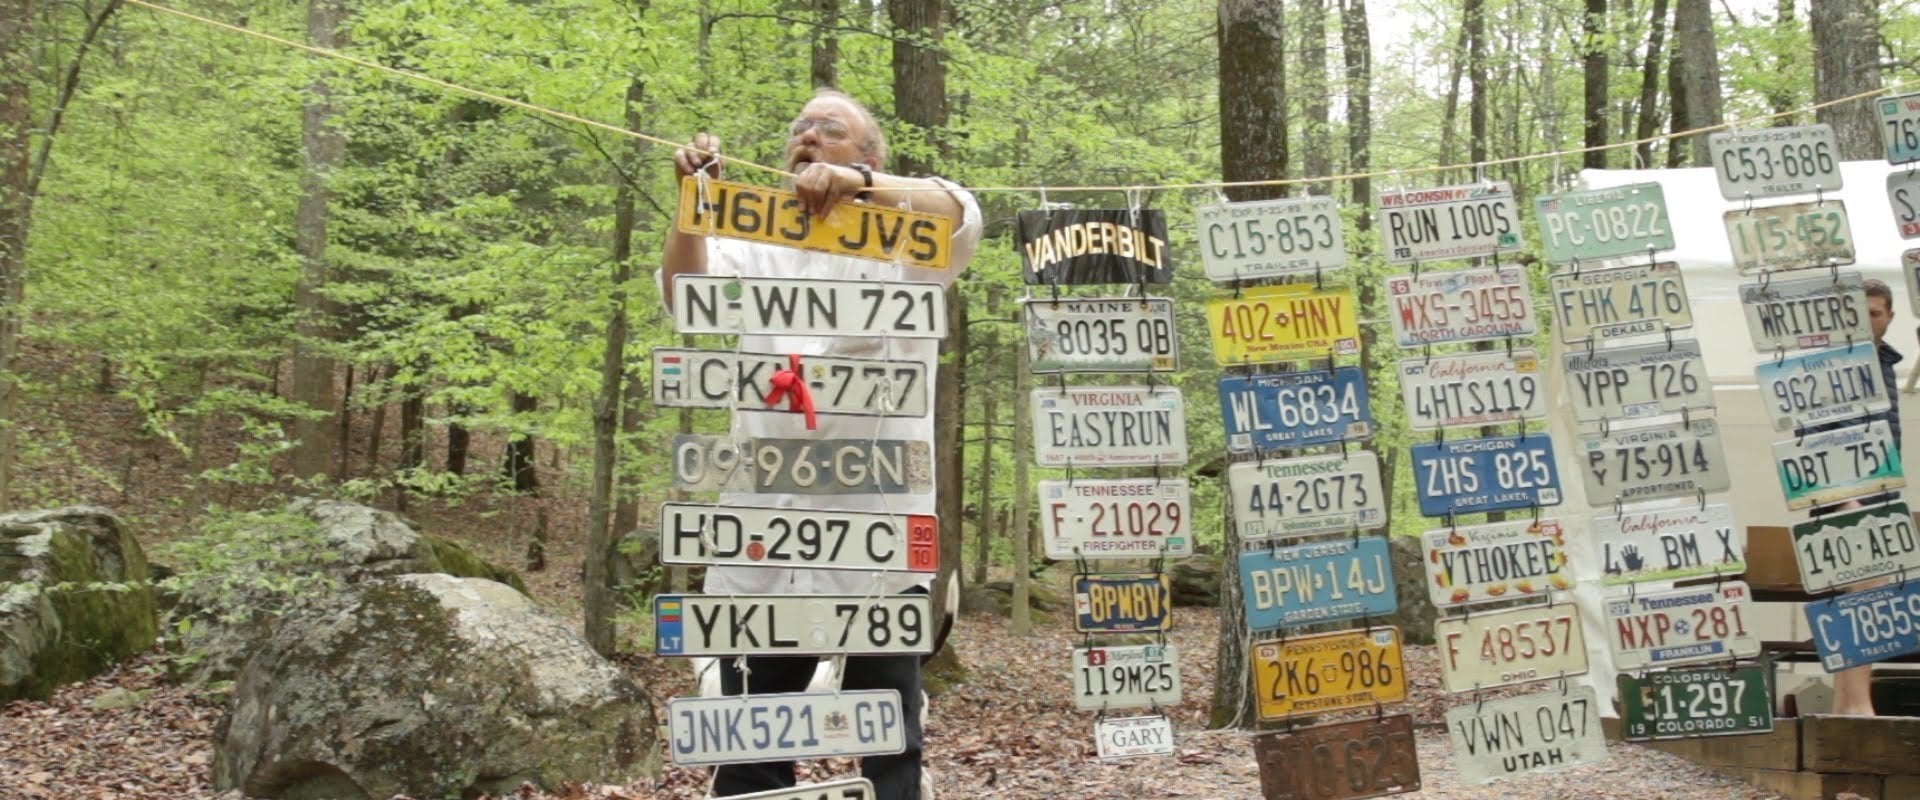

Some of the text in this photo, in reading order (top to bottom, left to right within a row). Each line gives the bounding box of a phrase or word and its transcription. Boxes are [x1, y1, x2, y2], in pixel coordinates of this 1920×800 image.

[1887, 117, 1920, 152] 76
[1381, 190, 1453, 206] WISCONSIN
[1762, 183, 1803, 193] TRAILER
[693, 188, 938, 262] H613 JVS
[1390, 208, 1440, 247] RUN
[1546, 202, 1664, 248] PC-0822
[1025, 222, 1164, 273] VANDERBILT
[1245, 259, 1309, 272] TRAILER
[1583, 270, 1648, 286] GEORGIA
[861, 289, 935, 332] 721
[1067, 304, 1132, 314] MAINE
[1397, 286, 1525, 331] WXS-3455
[1559, 279, 1682, 327] FHK 476
[1222, 297, 1342, 344] 402 HNY
[1757, 294, 1859, 338] WRITERS
[1057, 319, 1170, 355] 8035 QB
[1411, 323, 1522, 342] NORTH CAROLINA
[1602, 323, 1654, 338] DEKALB
[1430, 361, 1505, 380] California
[661, 379, 681, 400] H
[1576, 361, 1698, 408] YPP 726
[1773, 363, 1876, 413] 962 HIN
[1072, 393, 1142, 406] VIRGINIA
[1229, 382, 1360, 433] WL 6834
[1416, 376, 1536, 419] 4HTS119
[1049, 410, 1172, 447] EASYRUN
[1266, 432, 1296, 442] GREAT
[1302, 428, 1334, 438] LAKES
[1616, 430, 1677, 446] VIRGINIA
[1450, 440, 1516, 454] MICHIGAN
[1266, 460, 1343, 479] Tennessee
[1616, 440, 1709, 482] 75-914
[1782, 451, 1831, 492] DBT
[1845, 439, 1893, 478] 751
[1421, 450, 1551, 497] ZHS 825
[1075, 485, 1153, 496] TENNESSEE
[1250, 473, 1368, 519] 44-2G73
[1622, 480, 1694, 498] APPORTIONED
[1455, 496, 1488, 508] GREAT
[914, 526, 932, 541] 90
[1621, 514, 1702, 534] California
[865, 521, 896, 563] C
[1468, 527, 1519, 543] Virginia
[1083, 541, 1156, 550] FIREFIGHTER
[1274, 544, 1352, 562] NEW JERSEY
[1660, 532, 1701, 570] BM
[1716, 528, 1738, 564] X
[914, 550, 930, 565] 10
[1440, 539, 1561, 586] VTHOKEE
[1836, 561, 1895, 582] COLORADO
[1251, 555, 1387, 610] BPW 14J
[1639, 593, 1714, 611] Tennessee
[1838, 591, 1894, 608] MICHIGAN
[1284, 602, 1363, 622] GARDEN STATE
[691, 604, 922, 648] YKL 789
[1616, 604, 1747, 650] NXP 281
[1817, 613, 1841, 652] C
[660, 637, 680, 650] LT
[1285, 638, 1366, 657] PENNSYLVANIA
[1446, 616, 1572, 672] F 48537
[1660, 644, 1712, 658] FRANKLIN
[1860, 640, 1902, 657] TRAILER
[1093, 653, 1102, 664] 3
[1082, 664, 1174, 696] 119M25
[1268, 648, 1393, 700] 2K6 986
[1502, 669, 1538, 683] OHIO
[1654, 672, 1731, 684] COLORFUL
[1292, 692, 1374, 710] KEYSTONE STATE
[676, 701, 896, 755] JNK521 GP
[1458, 699, 1588, 756] VWN 047
[1631, 716, 1764, 734] 19 COLORADO 51
[1112, 727, 1165, 747] GARY
[1503, 748, 1563, 773] UTAH
